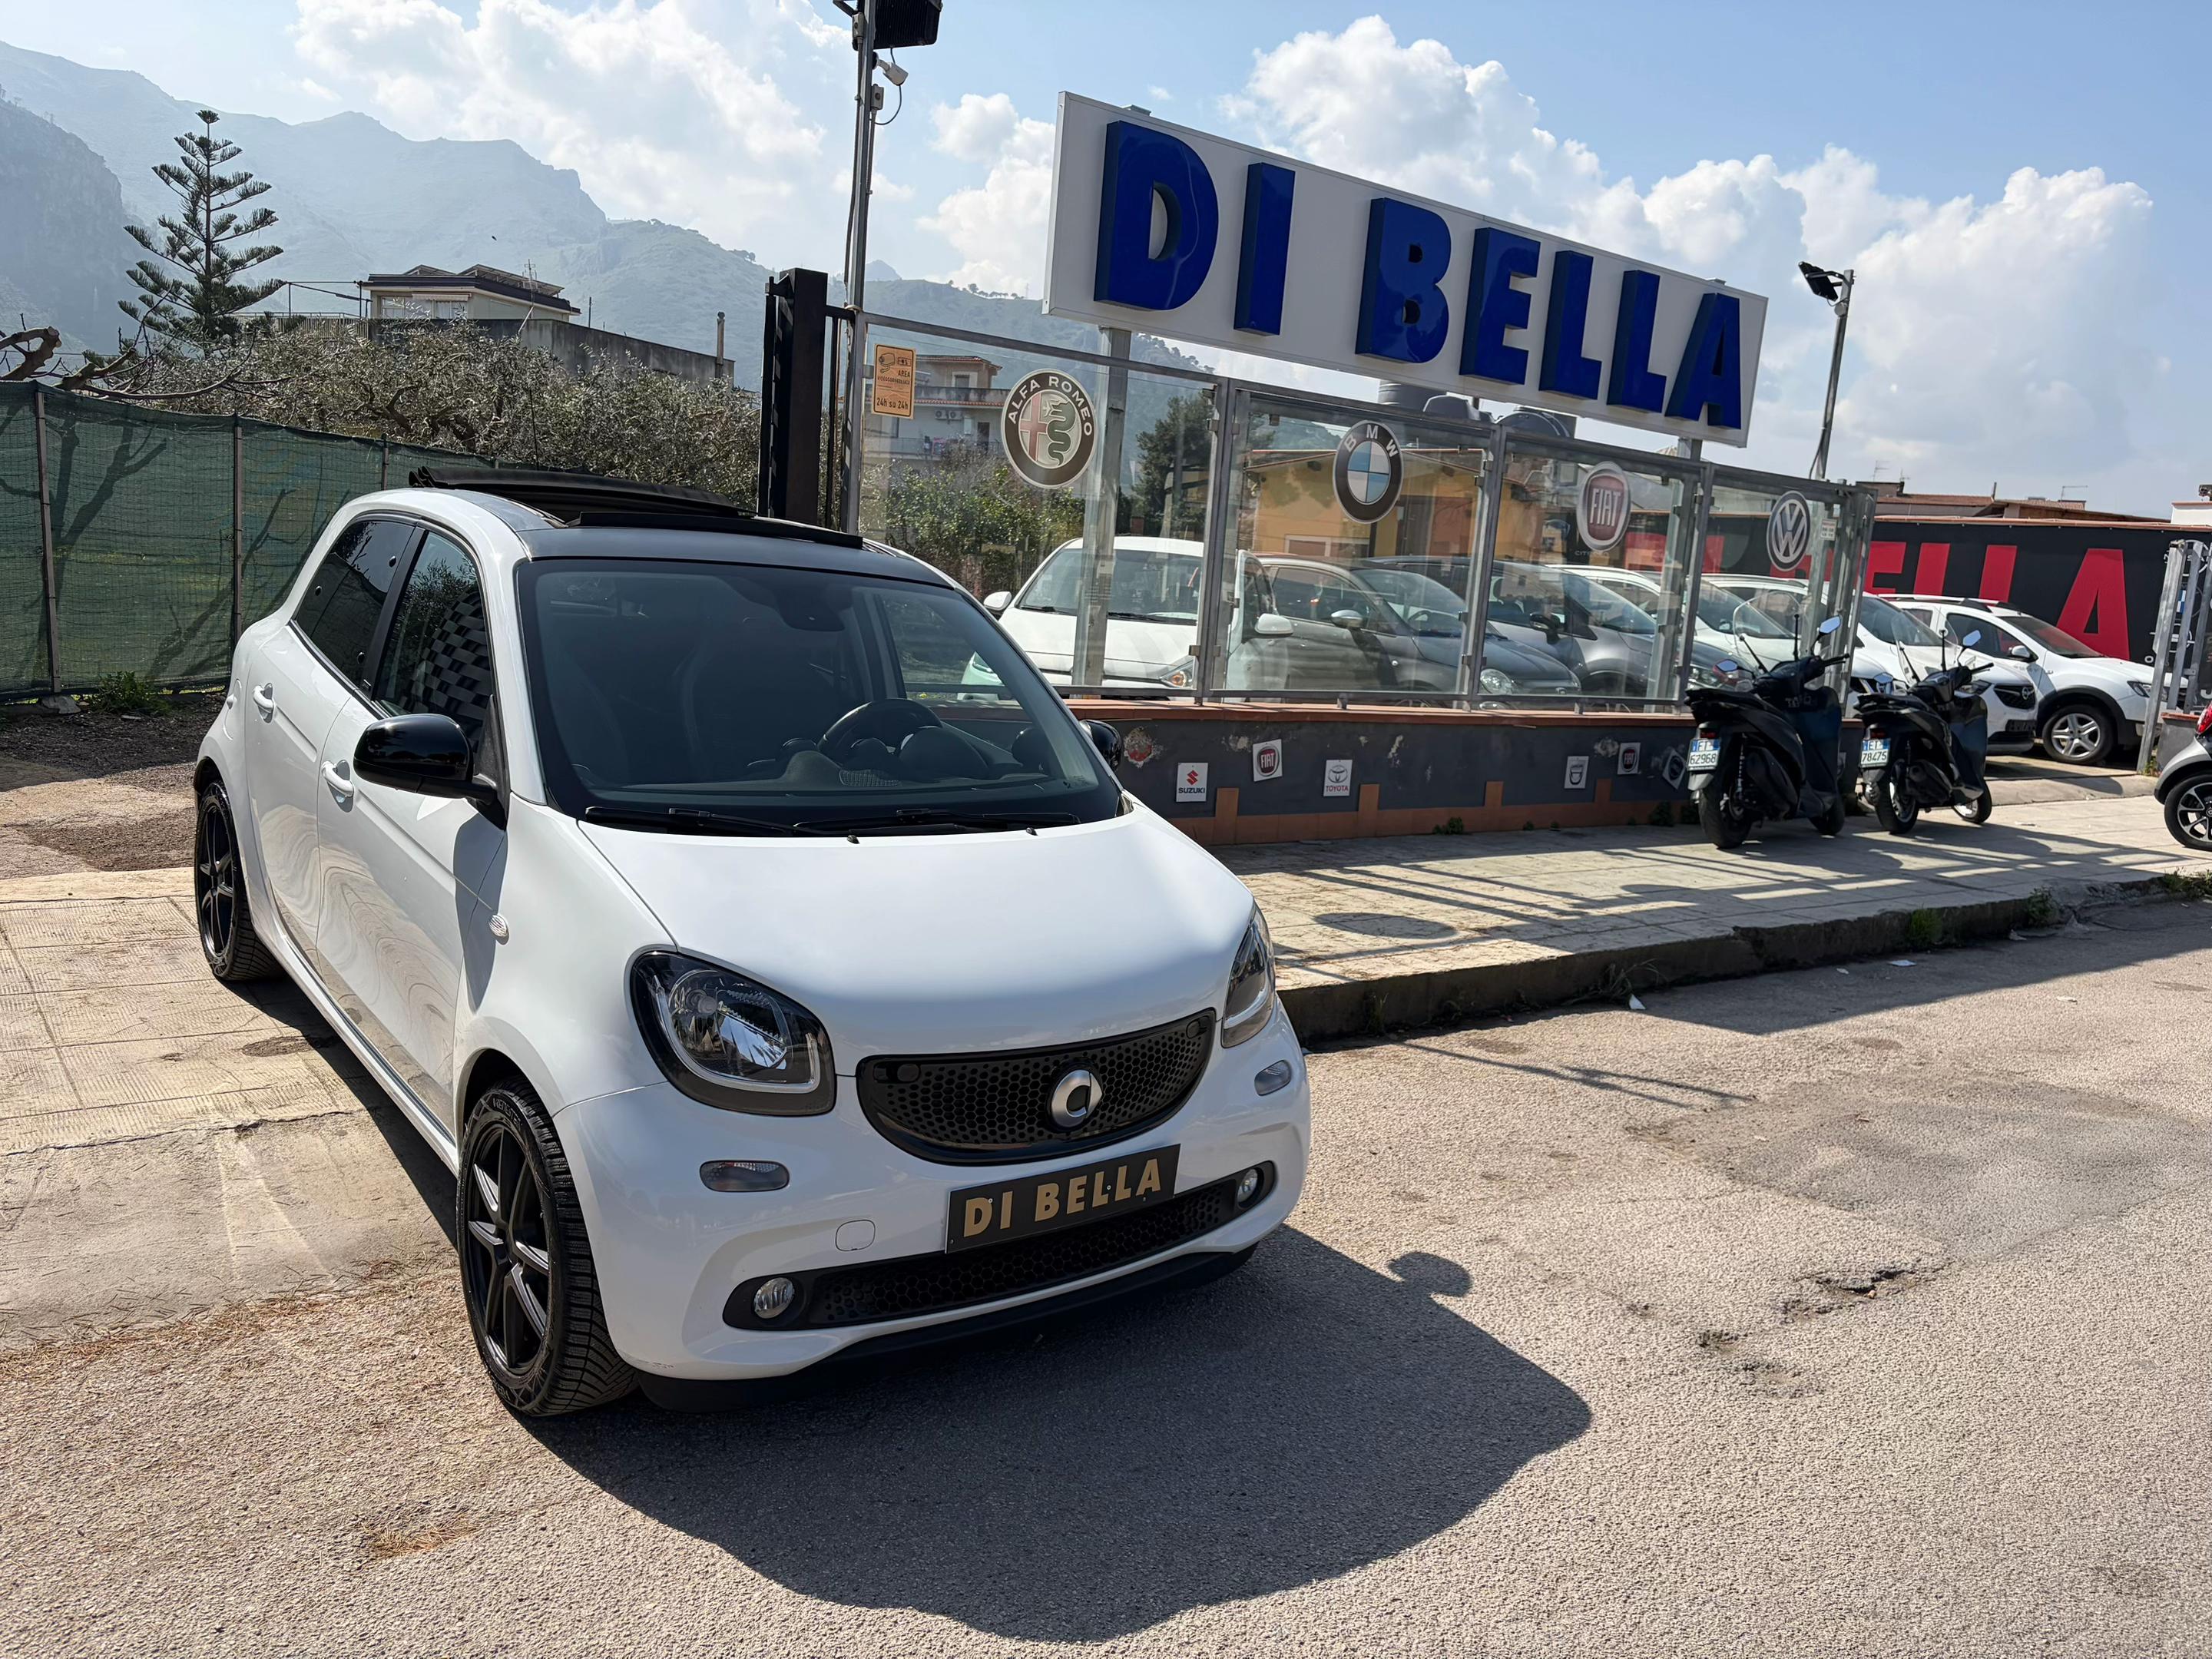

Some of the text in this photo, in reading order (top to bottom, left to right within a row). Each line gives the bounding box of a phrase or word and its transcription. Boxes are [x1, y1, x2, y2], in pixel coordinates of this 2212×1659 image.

[1094, 119, 1743, 431] DI BELLA
[876, 397, 887, 407] 24h
[898, 400, 909, 410] 24h
[1008, 376, 1093, 436] ALFA ROMEO
[1343, 424, 1399, 458] BMW
[1589, 487, 1621, 527] FIAT
[1260, 753, 1275, 769] FIAT
[1690, 753, 1717, 765] 62968
[1862, 750, 1887, 763] 78475
[963, 1157, 1161, 1237] DI BELLA
